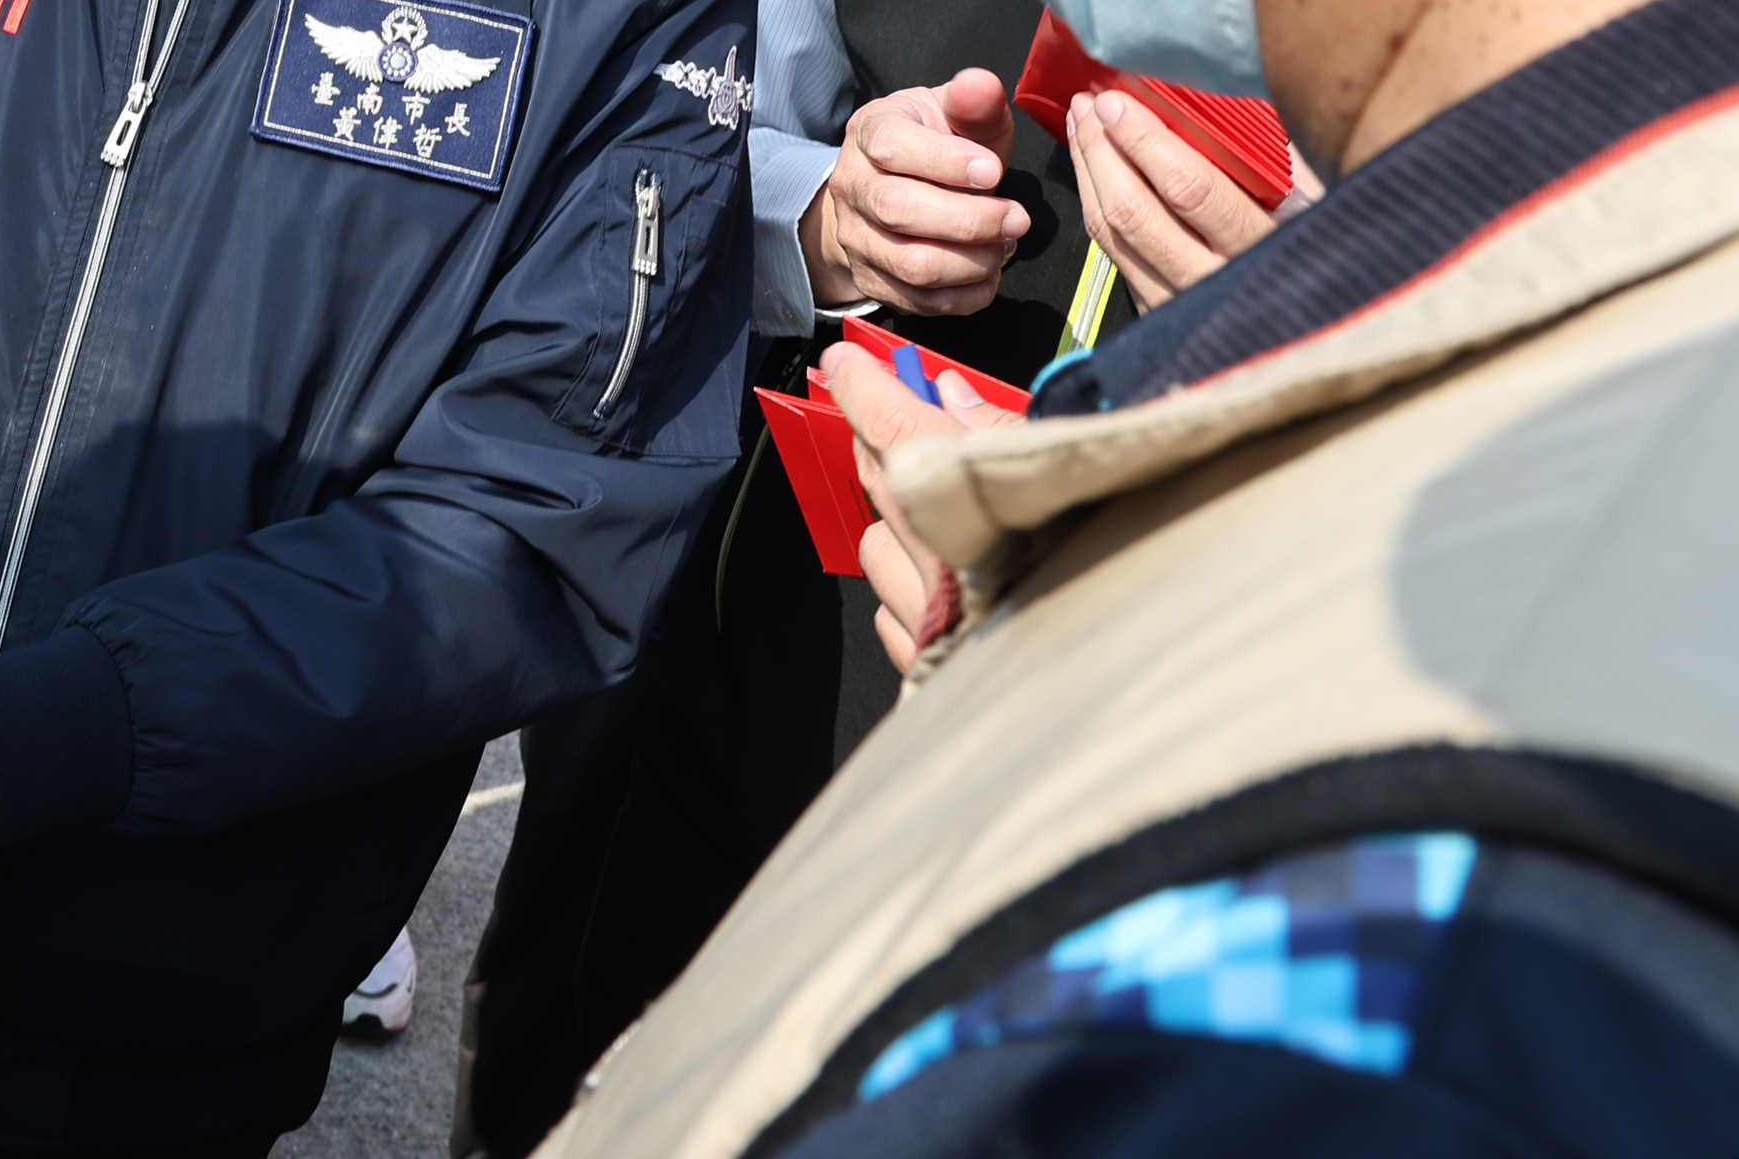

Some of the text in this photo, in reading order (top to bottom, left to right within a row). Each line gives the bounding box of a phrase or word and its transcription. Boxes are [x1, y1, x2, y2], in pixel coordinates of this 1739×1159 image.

[311, 71, 471, 137] 臺南市長
[332, 106, 443, 159] 黃偉哲
